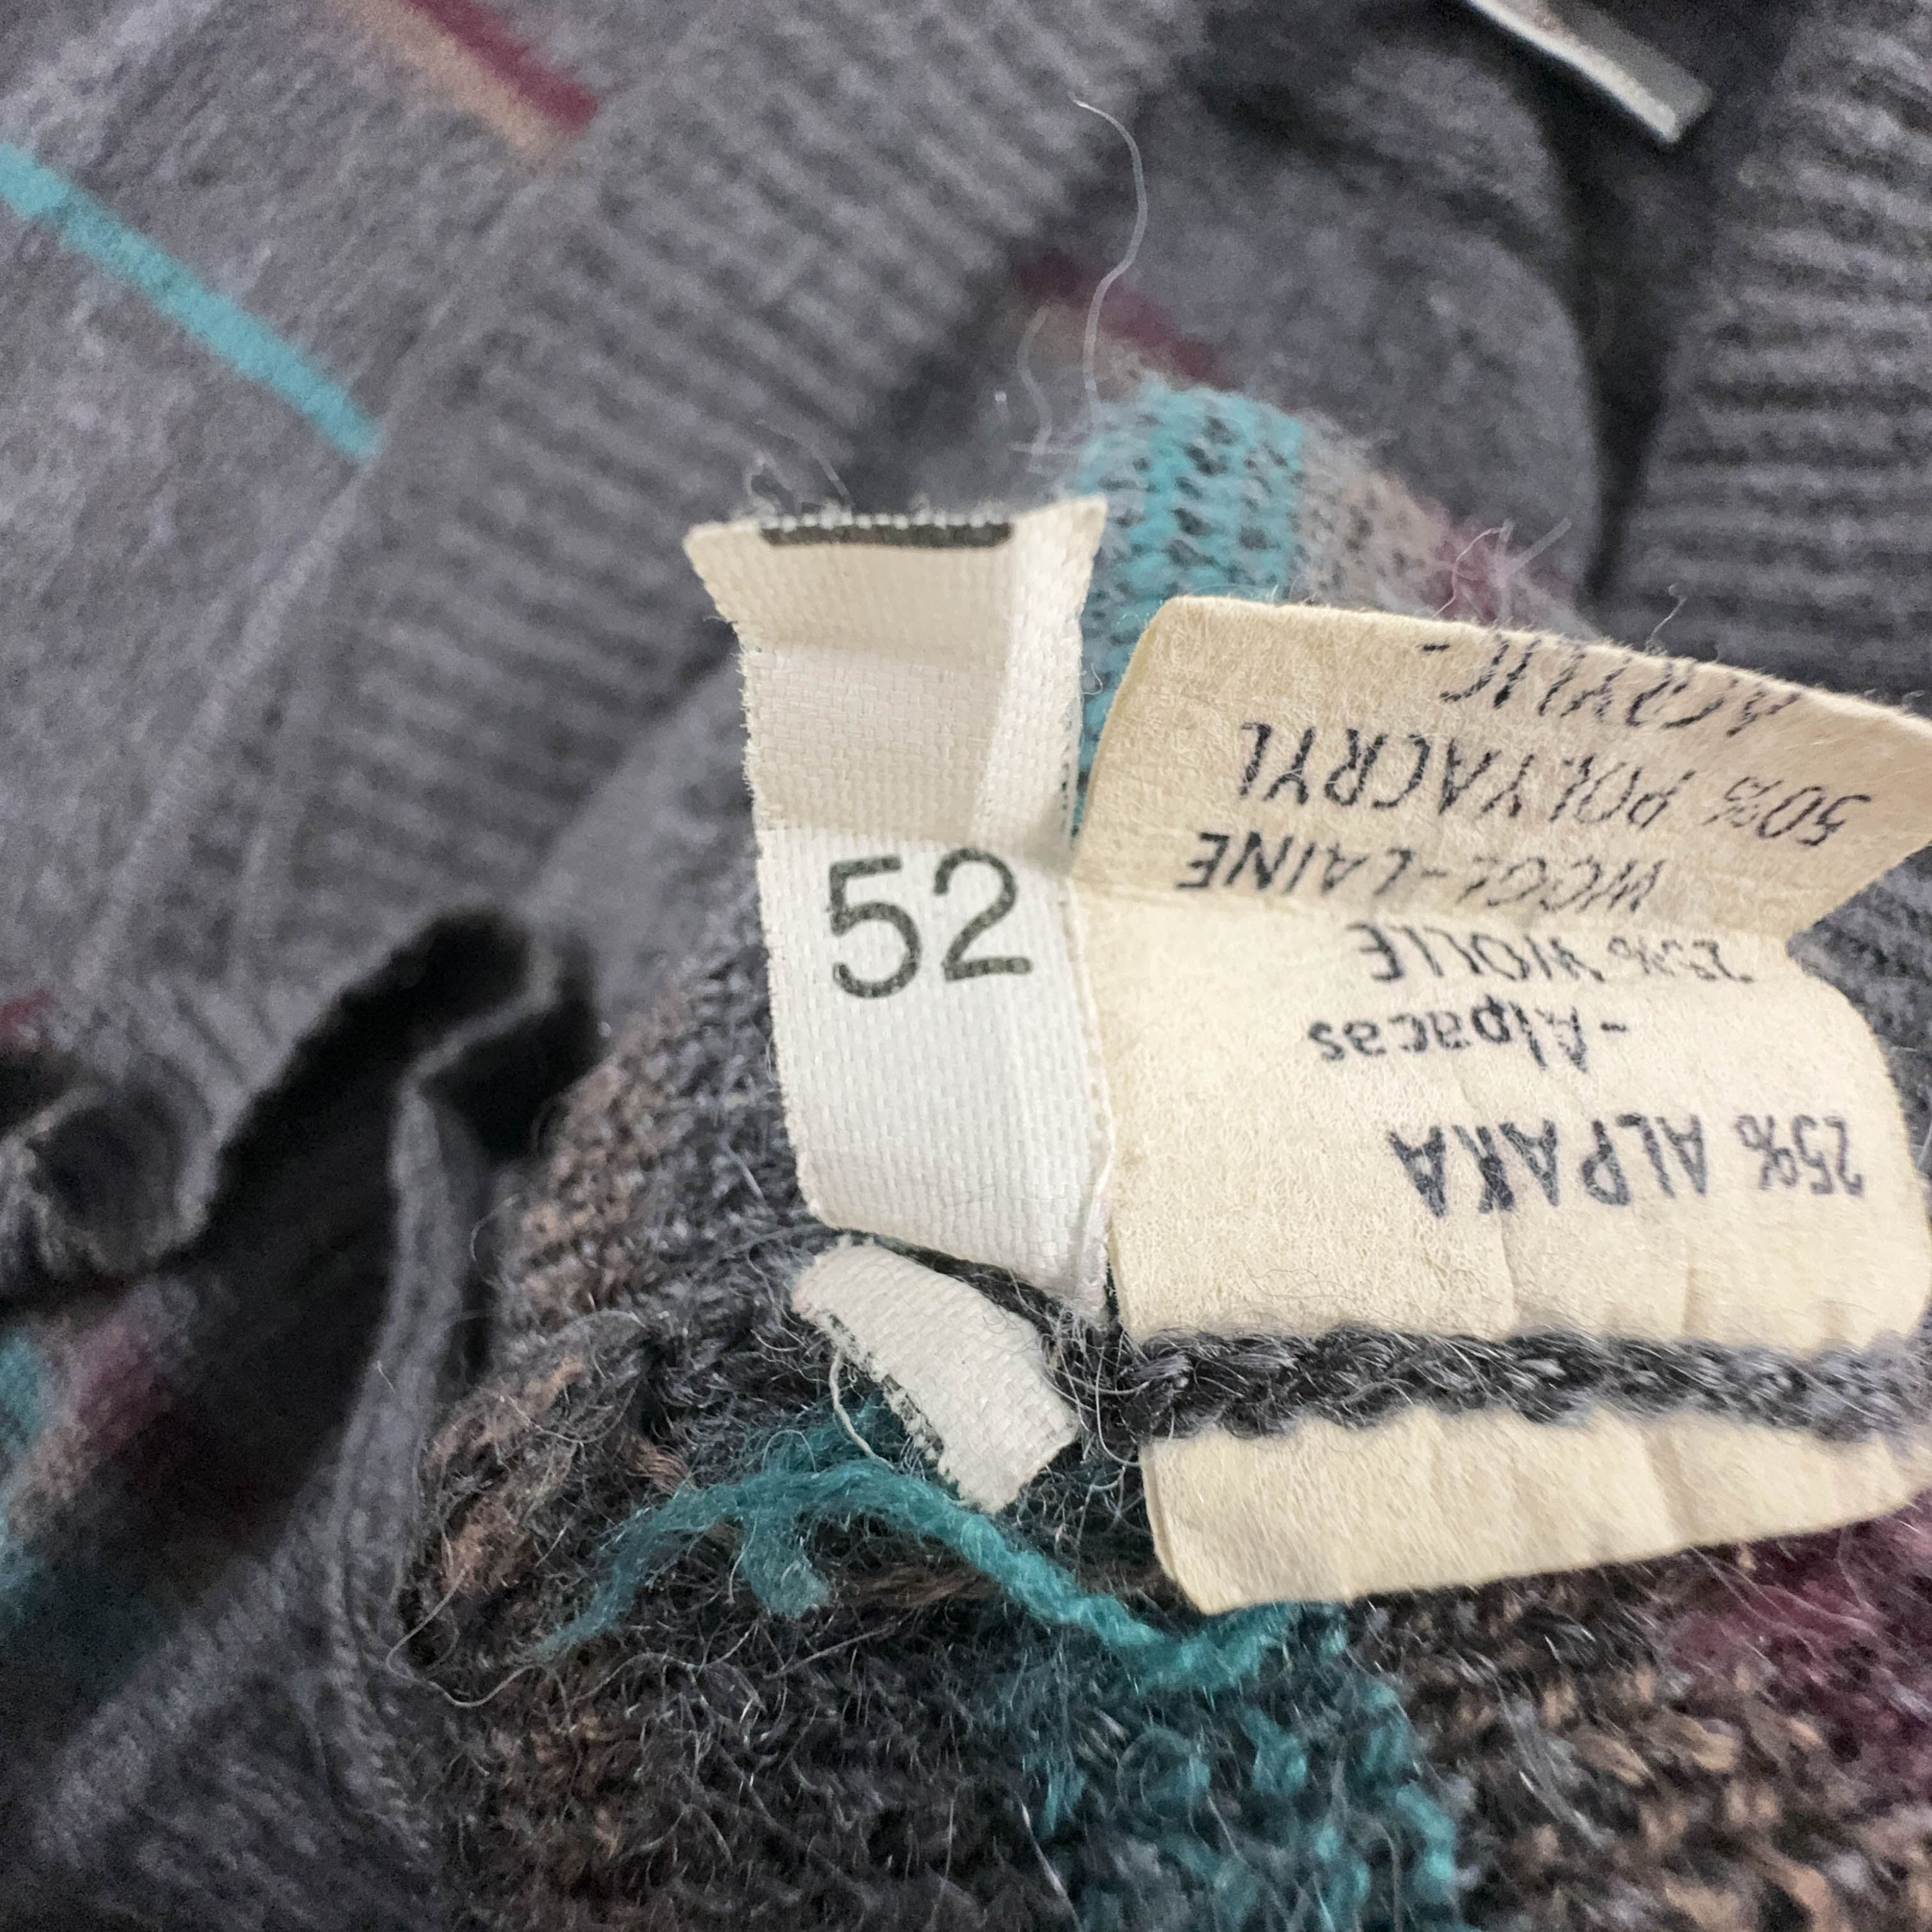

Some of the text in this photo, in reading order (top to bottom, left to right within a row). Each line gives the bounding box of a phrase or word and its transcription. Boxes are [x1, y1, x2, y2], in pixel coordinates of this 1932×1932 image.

[1238, 722, 1873, 848] 50% POLYACRYL
[826, 846, 1035, 1000] 52
[1346, 923, 1606, 985] WOLLE
[1386, 1112, 1866, 1220] 25% ALPAKA
